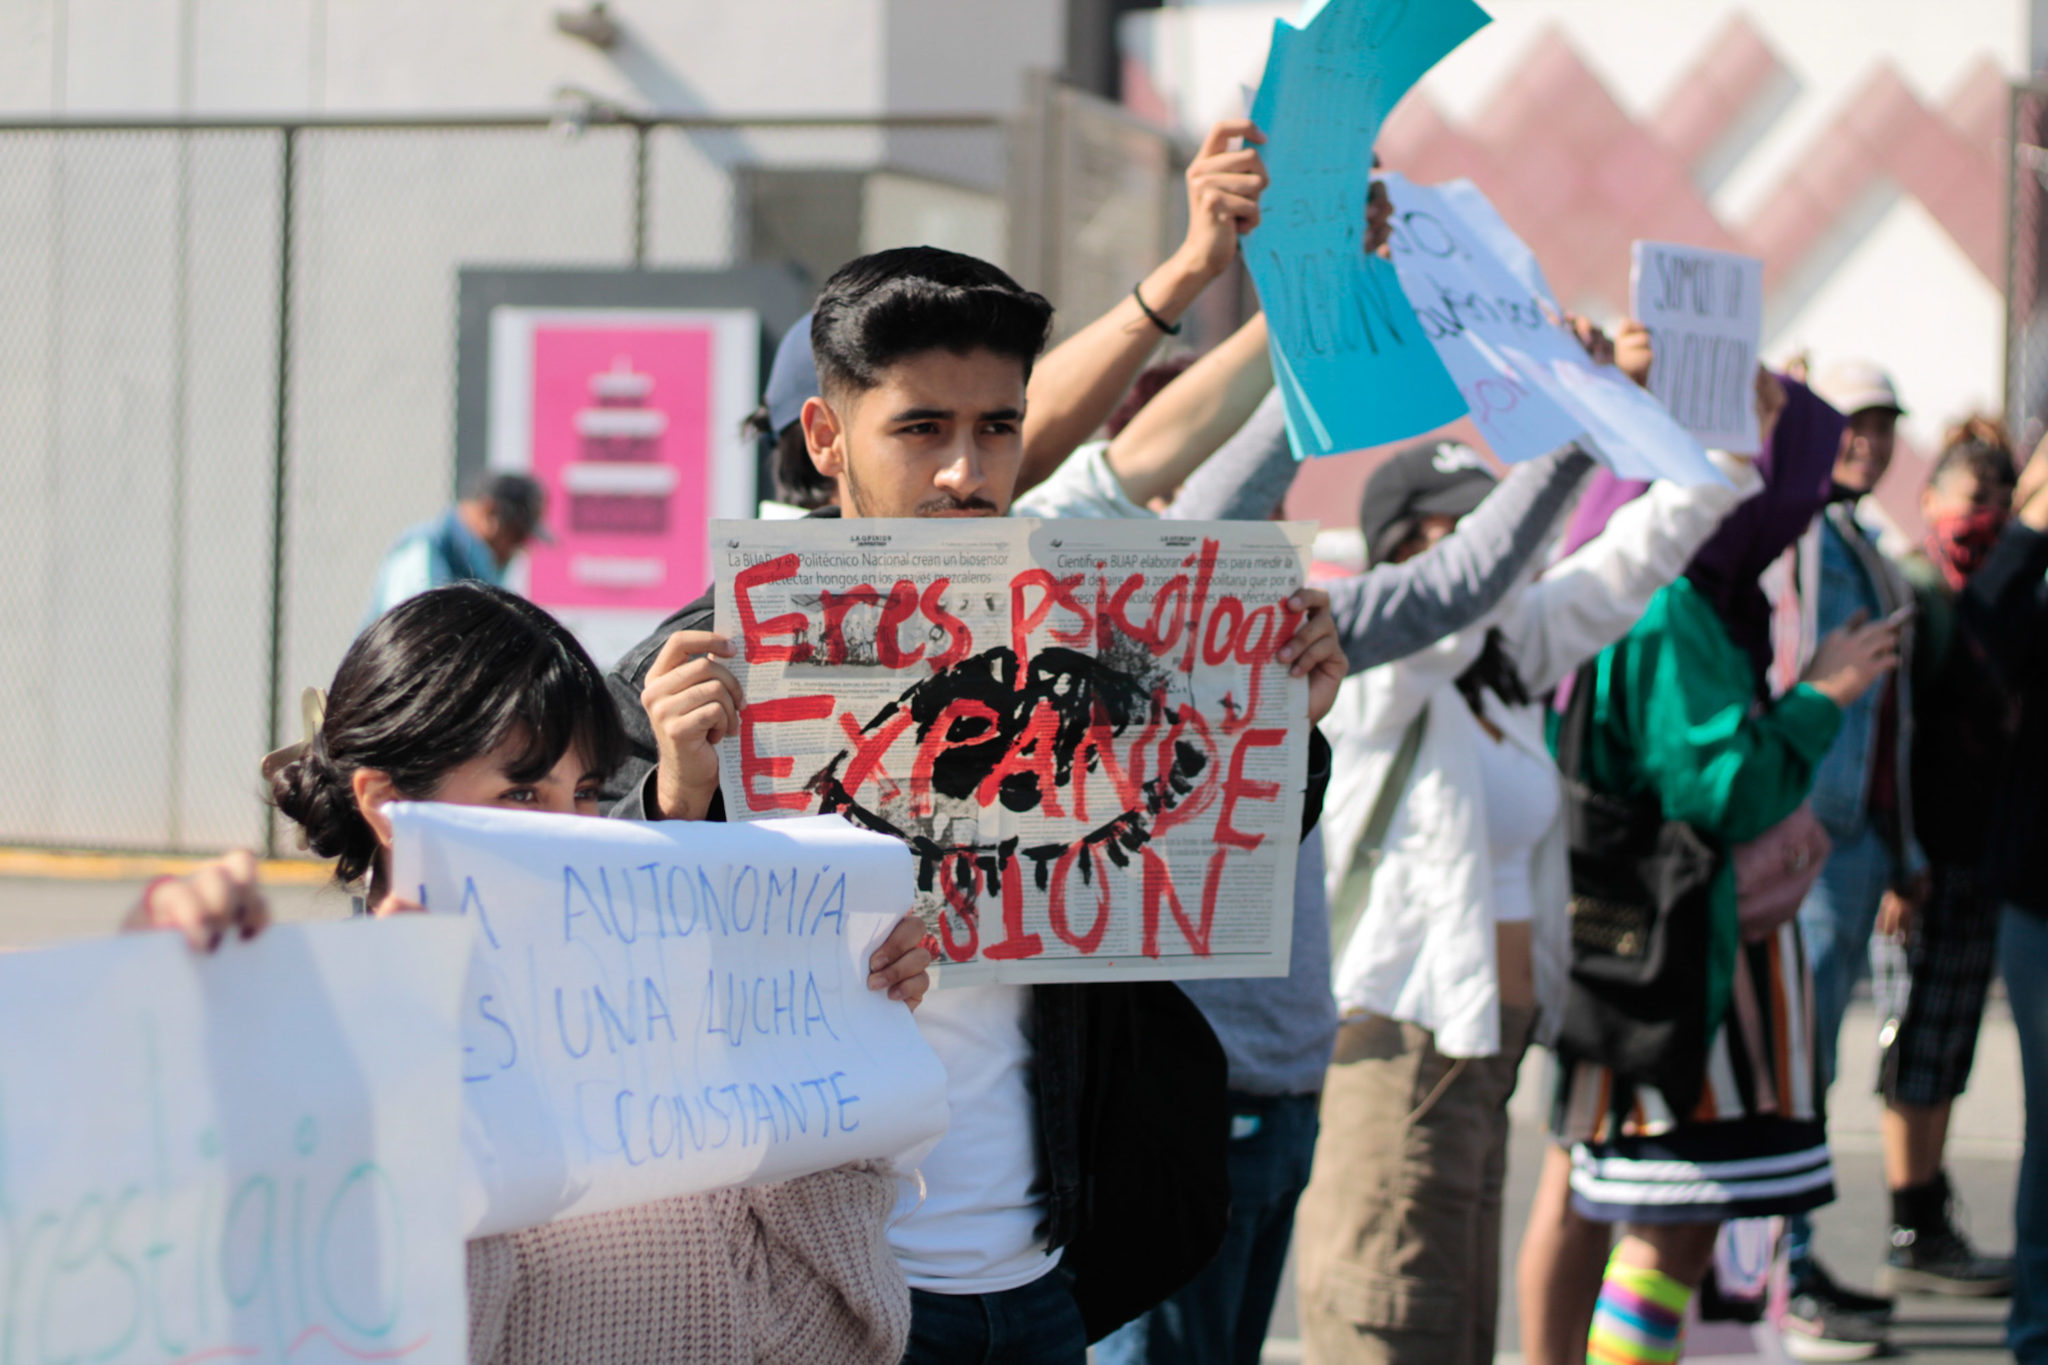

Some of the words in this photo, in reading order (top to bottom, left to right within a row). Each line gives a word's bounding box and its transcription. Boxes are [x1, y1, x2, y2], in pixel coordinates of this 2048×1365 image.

[728, 552, 741, 567] La
[798, 552, 860, 568] Politécnico
[861, 552, 910, 568] Nacional
[912, 555, 942, 567] crean
[944, 555, 957, 567] un
[959, 553, 1009, 567] biosensor
[816, 571, 860, 589] hongos
[862, 574, 877, 586] en
[879, 571, 893, 586] los
[1110, 555, 1139, 568] BUAP
[1230, 559, 1252, 572] para
[1249, 577, 1270, 590] que
[734, 552, 973, 670] Eres
[738, 686, 1287, 849] EXPANDE
[562, 863, 847, 945] AUTONOMÍA
[554, 969, 678, 1059] UNA
[706, 968, 841, 1048] LUCHA
[613, 1070, 862, 1167] CONSTANTE
[0, 1006, 402, 1365] restigio
